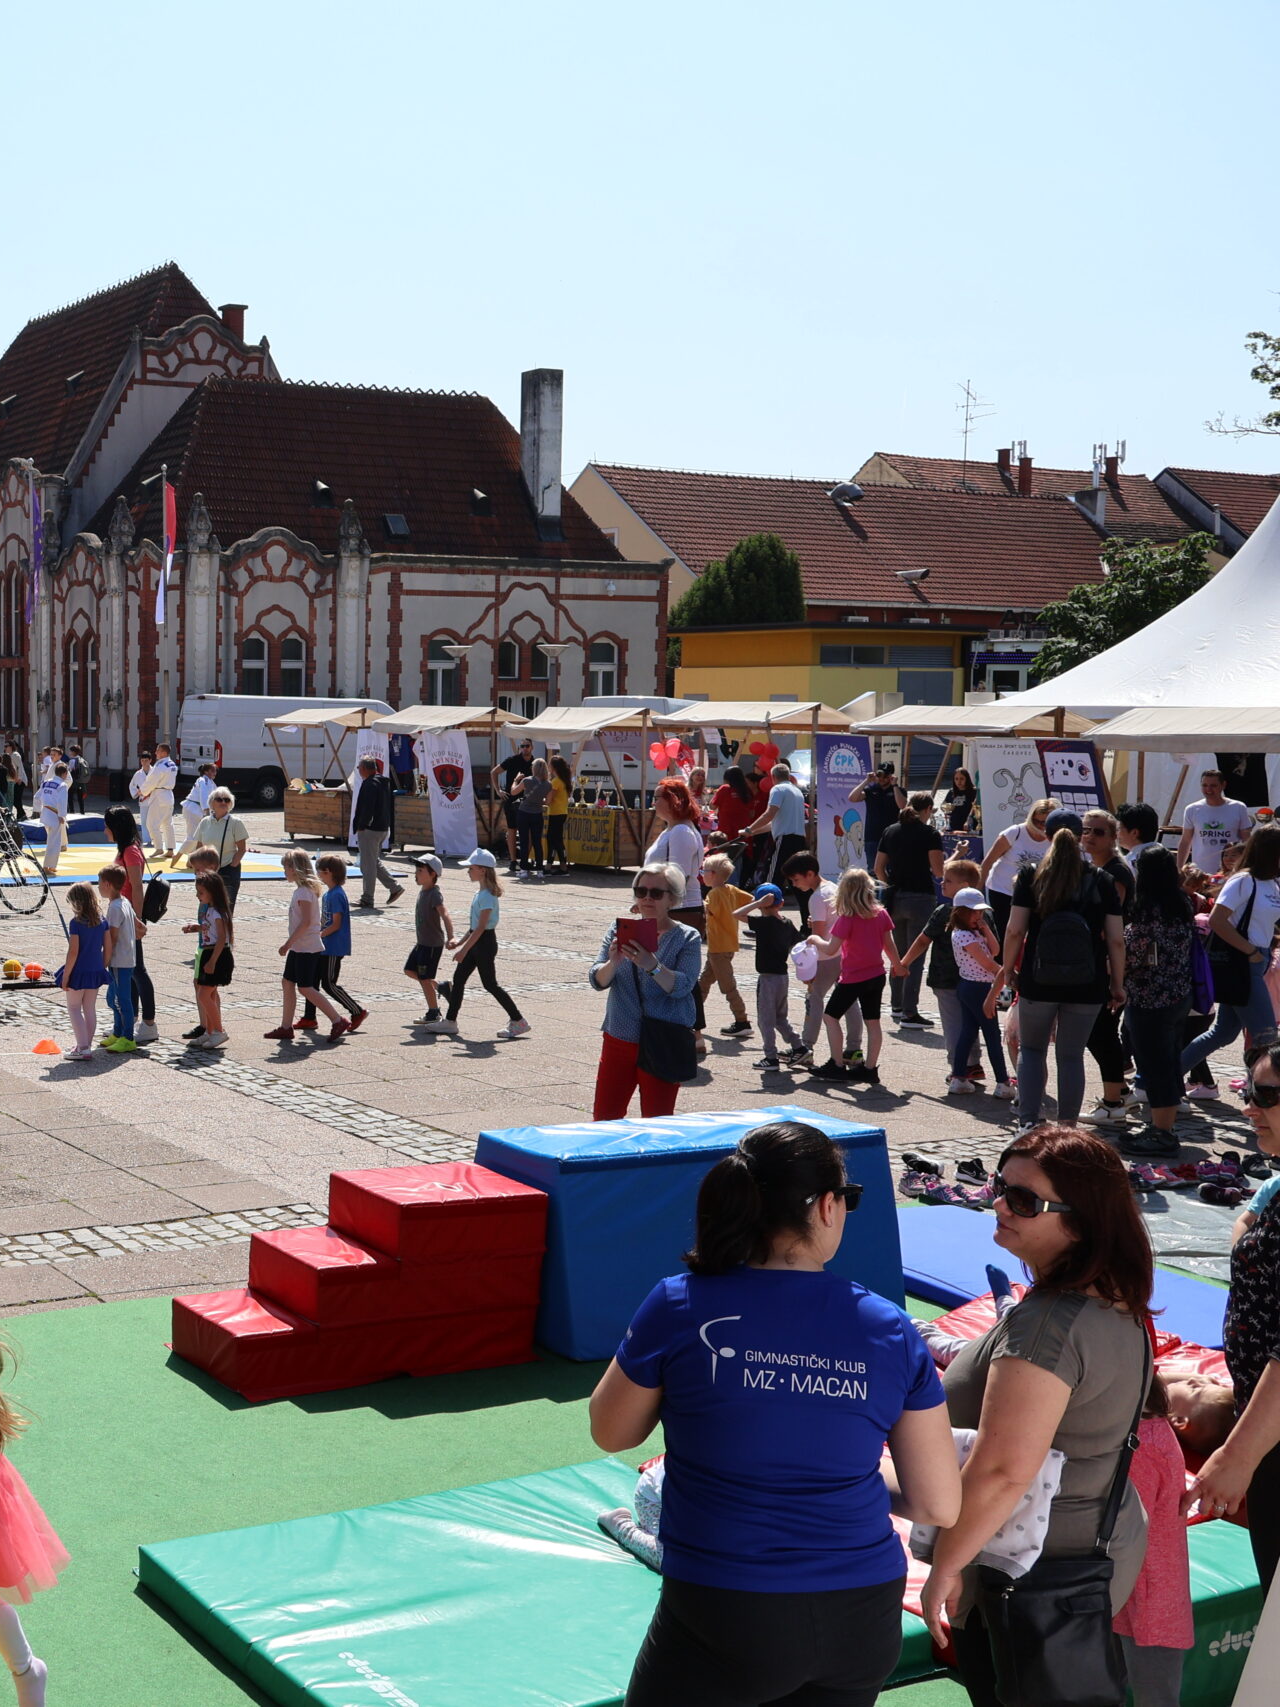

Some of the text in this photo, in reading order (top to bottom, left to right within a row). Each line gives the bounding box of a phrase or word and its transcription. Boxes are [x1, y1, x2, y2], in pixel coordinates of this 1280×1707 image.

[834, 752, 855, 768] ČPK
[1199, 830, 1231, 839] SPRING
[744, 1350, 867, 1375] GIMNASTIČKI KLUB
[743, 1368, 868, 1401] MZ MACAN
[1208, 1624, 1258, 1657] educ'
